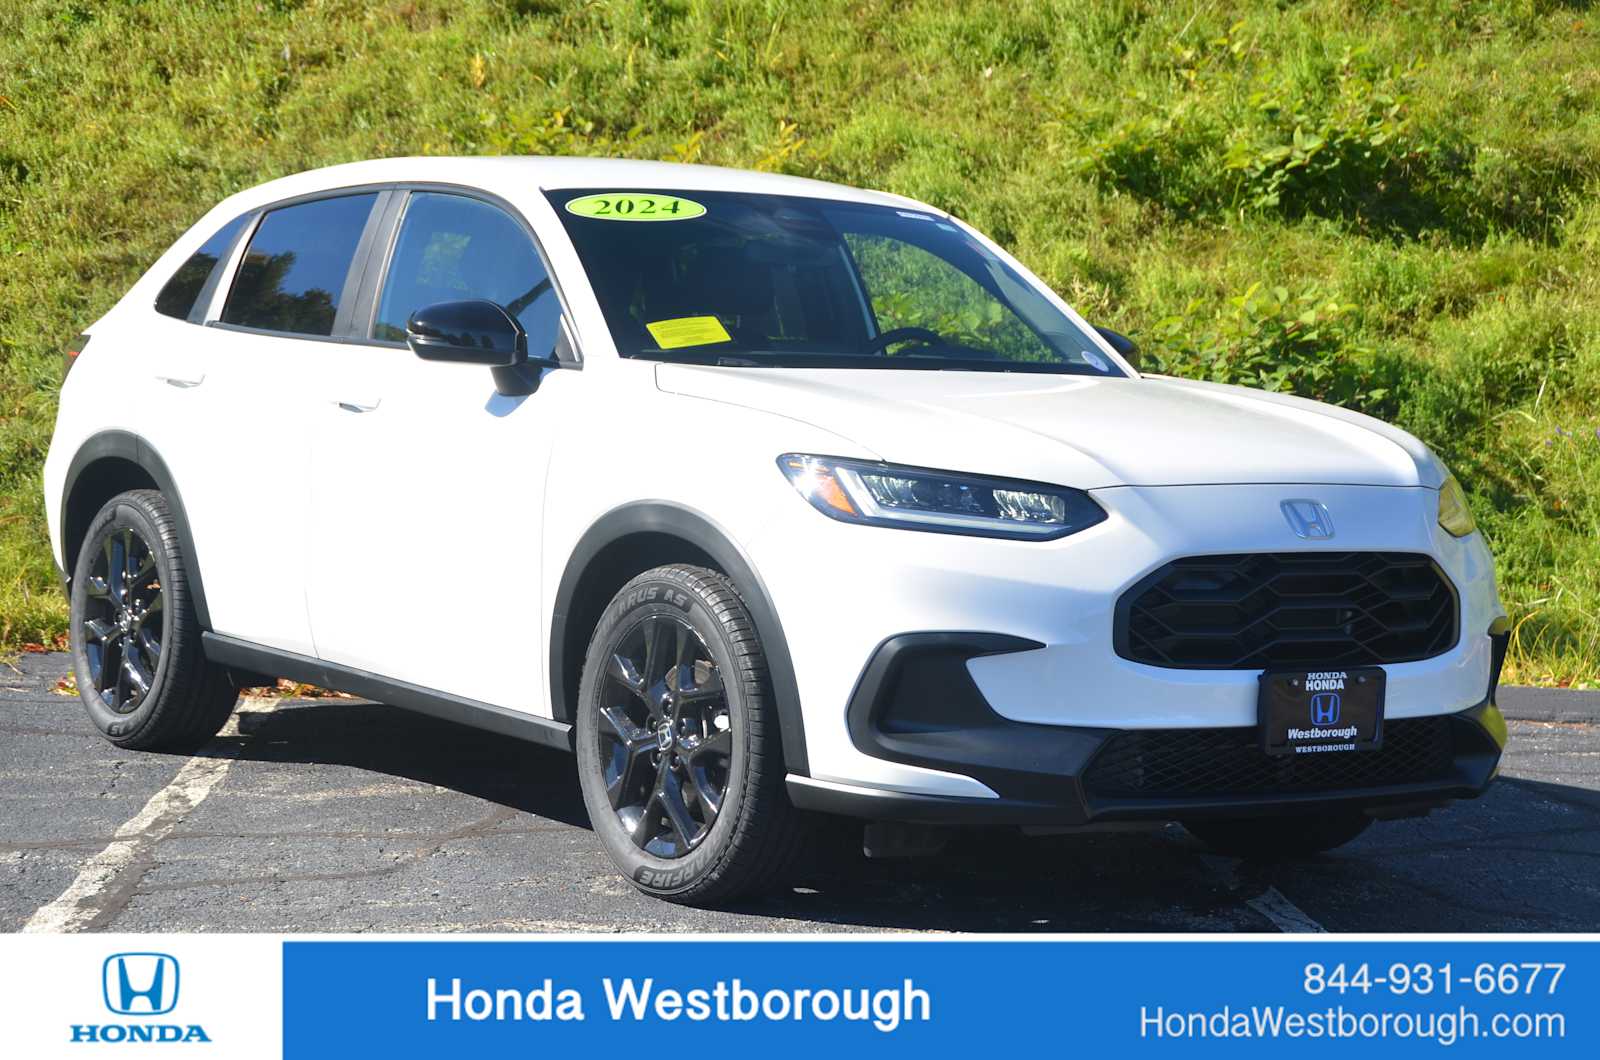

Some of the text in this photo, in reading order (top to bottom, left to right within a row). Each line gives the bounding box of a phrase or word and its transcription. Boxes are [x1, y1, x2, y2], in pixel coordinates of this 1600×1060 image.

[594, 199, 681, 216] 2024
[1306, 671, 1347, 680] HONDA
[1305, 680, 1345, 691] HONDA
[1287, 725, 1358, 740] Westborough
[1295, 743, 1356, 754] WESTBOROUGH
